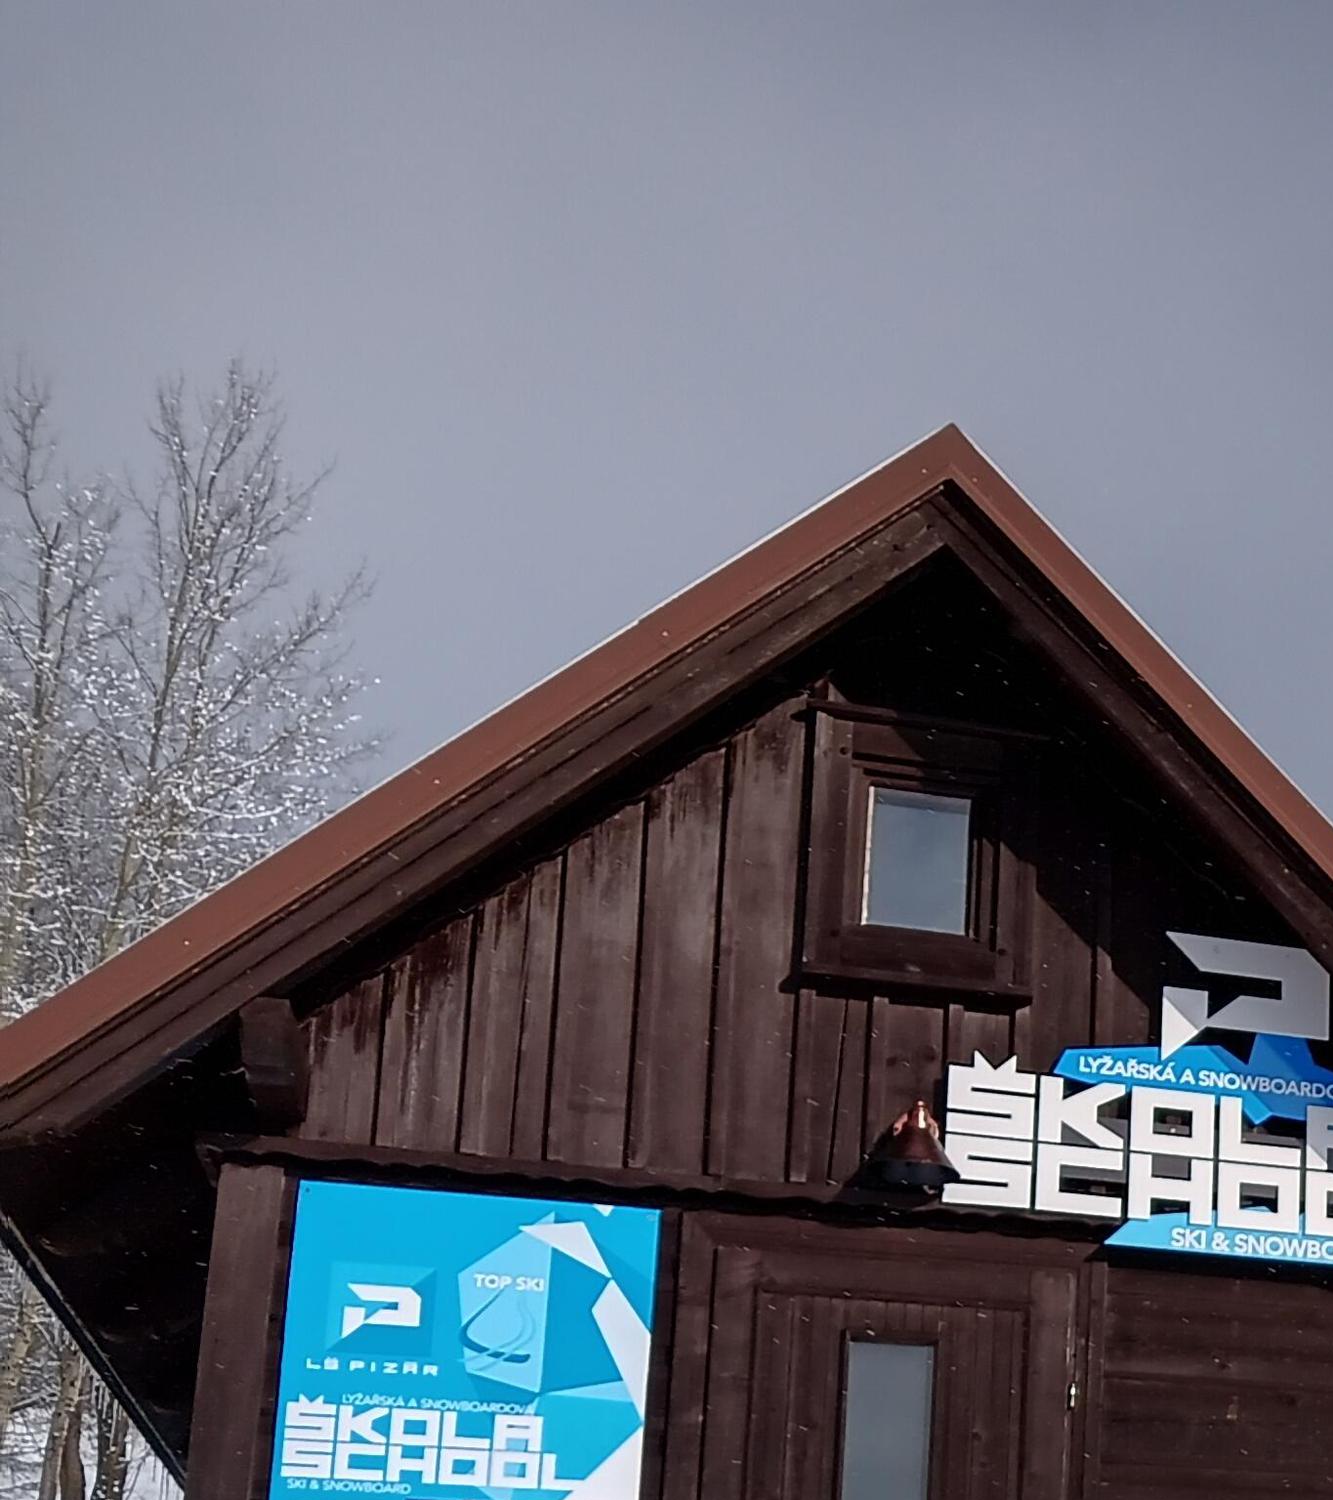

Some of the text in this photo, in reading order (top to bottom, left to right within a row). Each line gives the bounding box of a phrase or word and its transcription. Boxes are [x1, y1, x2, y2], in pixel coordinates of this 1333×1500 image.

[1079, 1054, 1176, 1083] LYŽAŘSKÁ
[1180, 1068, 1195, 1084] A
[1171, 1228, 1207, 1249] SKI
[1212, 1233, 1229, 1252] &
[473, 1273, 545, 1292] TOP SKI
[342, 1392, 536, 1416] LYŽAŘSKÁ A SNOWBOARDOVÁ
[284, 1393, 543, 1453] ŠKOLA
[281, 1439, 585, 1491] SCHOOL
[287, 1479, 411, 1495] SKI & SNOWBOARD
